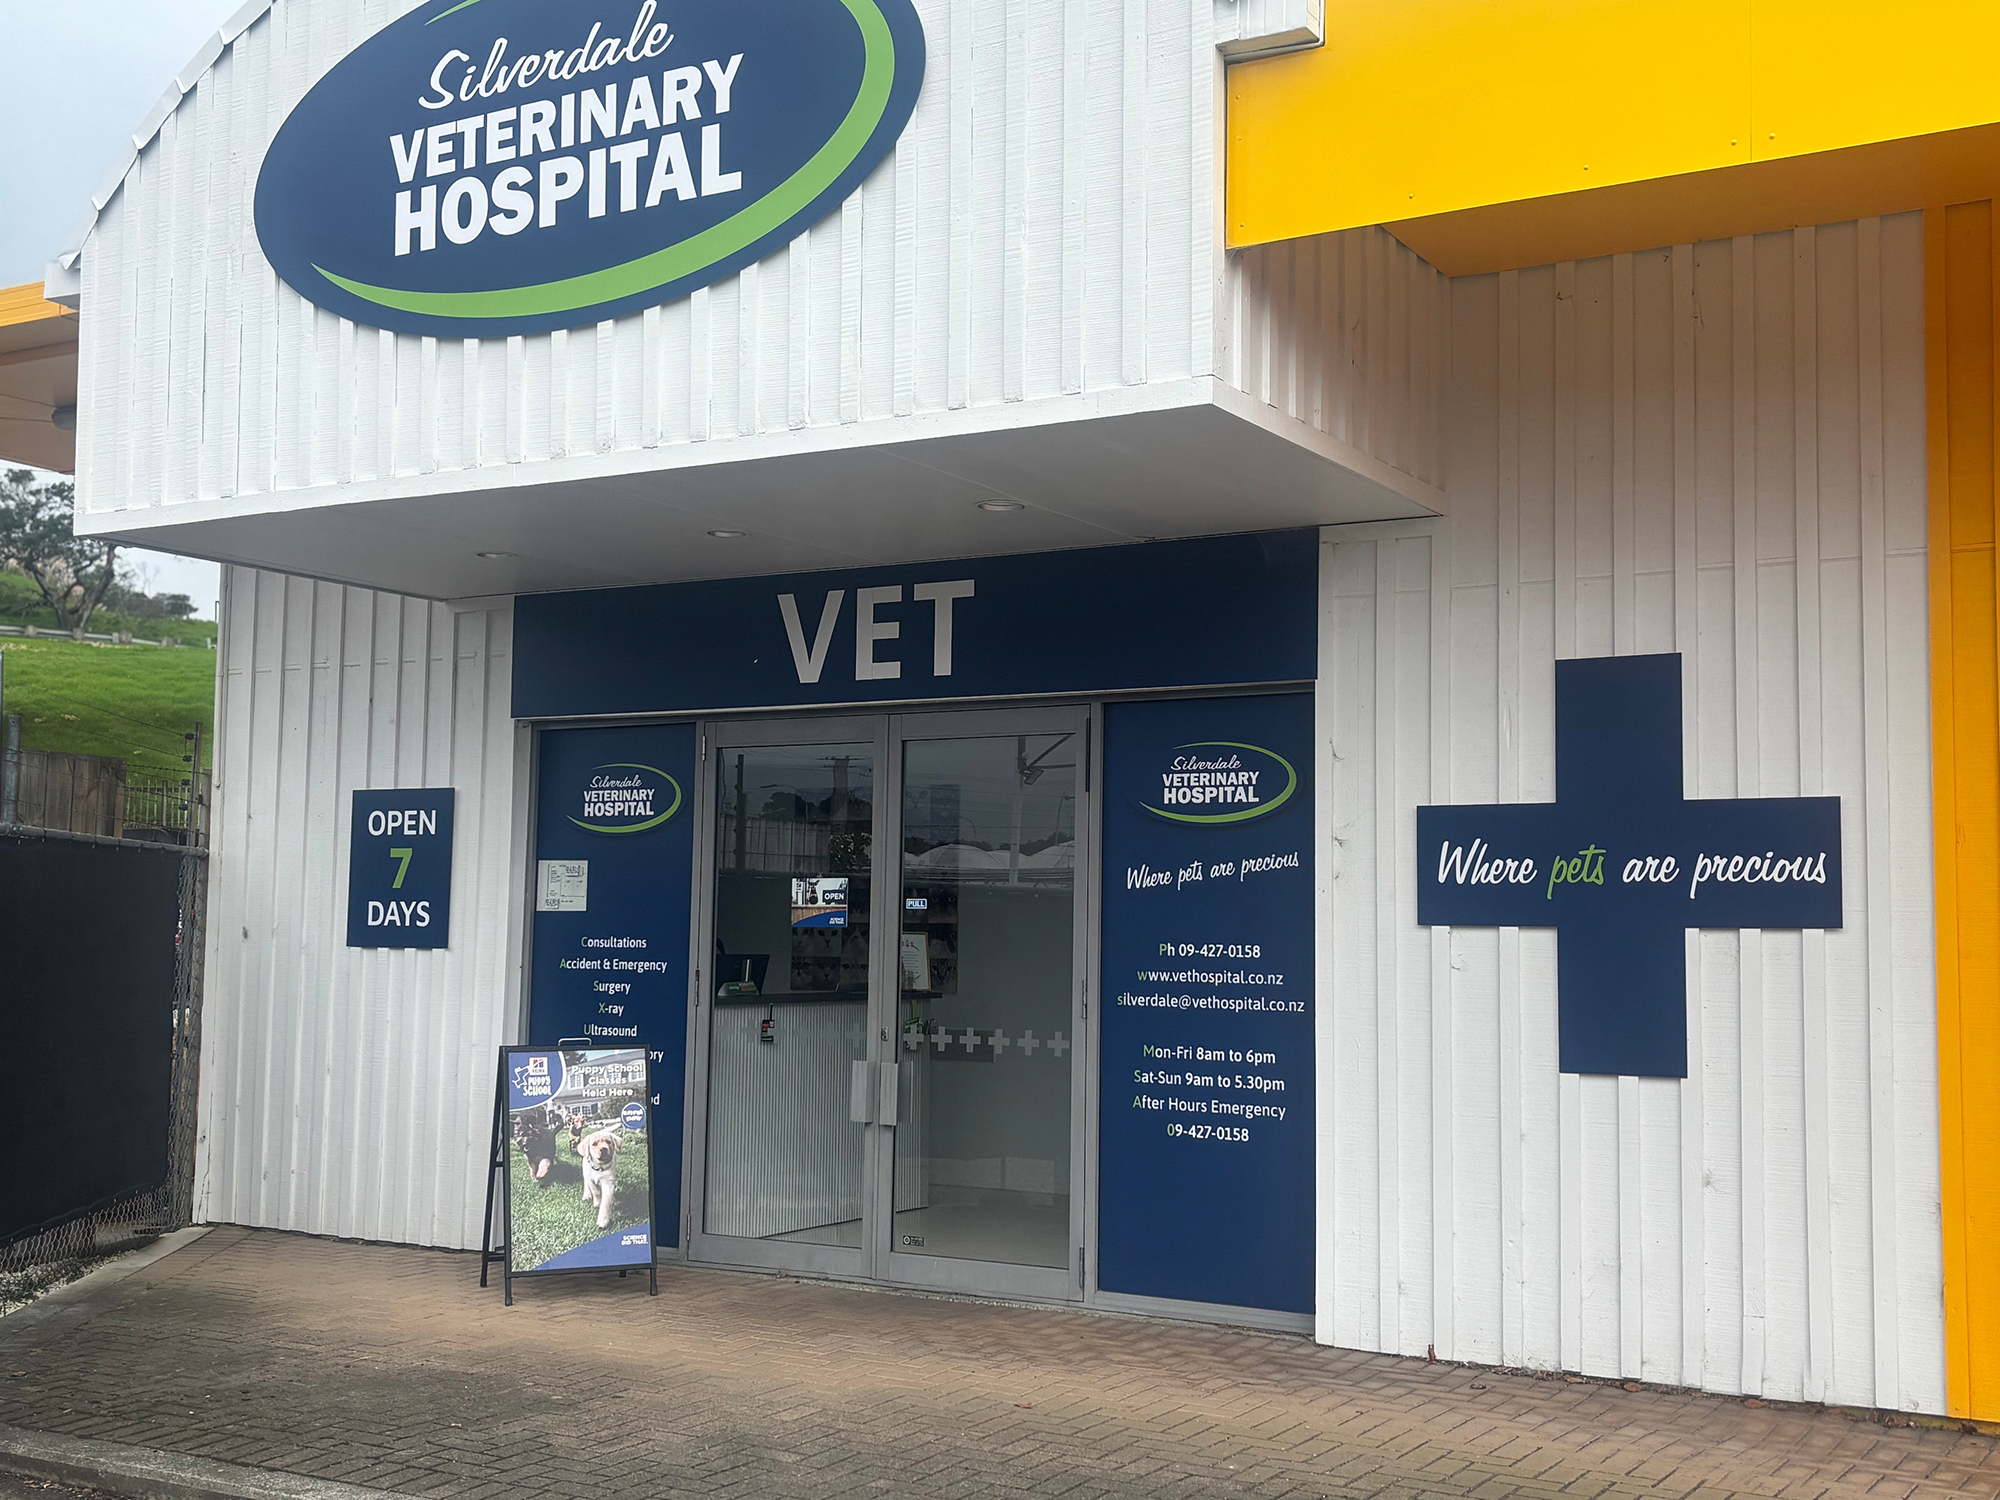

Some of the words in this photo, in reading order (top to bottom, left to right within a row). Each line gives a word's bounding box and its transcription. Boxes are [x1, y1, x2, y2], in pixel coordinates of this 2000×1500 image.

[418, 0, 675, 110] Silverdale
[389, 53, 745, 184] VETERINARY
[394, 123, 742, 257] HOSPITAL
[776, 578, 976, 684] VET
[1170, 755, 1242, 770] Silverdale
[590, 774, 642, 788] Silverdale
[1163, 771, 1259, 786] VETERINARY
[583, 789, 655, 802] VETERINARY
[1164, 785, 1259, 804] HOSPITAL
[584, 801, 654, 817] HOSPITAL
[367, 809, 437, 837] OPEN
[389, 847, 413, 889] 7
[1126, 863, 1173, 891] Where
[1177, 860, 1203, 891] pets
[1210, 862, 1236, 879] are
[1240, 851, 1299, 883] precious
[1437, 838, 1538, 886] Where
[1546, 844, 1607, 900] pets
[1621, 853, 1680, 885] are
[1689, 850, 1827, 900] precious
[367, 900, 430, 928] DAYS
[581, 936, 646, 949] Consultations
[1159, 943, 1175, 958] Ph
[1179, 943, 1261, 958] 09-427-0158
[559, 958, 601, 970] Accident
[603, 958, 611, 970] &
[613, 959, 667, 973] Emergency
[1137, 969, 1284, 986] www.vethospital.co.nz
[593, 980, 631, 994] Surgery
[598, 1003, 624, 1016] X-ray
[1117, 992, 1305, 1012] silverdale@vethospital.co.nz
[584, 1024, 637, 1036] Ultrasound
[1143, 1044, 1193, 1060] Mon-Fri
[1196, 1047, 1226, 1063] 8am
[1228, 1049, 1243, 1063] to
[1245, 1051, 1277, 1066] 6pm
[571, 1065, 605, 1074] Puppy
[528, 1076, 550, 1086] PUPPY
[588, 1077, 627, 1085] Classes
[1134, 1069, 1182, 1085] Sat-Sun
[1184, 1072, 1215, 1087] 9am
[1217, 1073, 1231, 1088] to
[1234, 1075, 1285, 1093] 5.30pm
[523, 1085, 552, 1096] SCHOOL
[582, 1088, 606, 1098] Held
[609, 1088, 633, 1096] Here
[1132, 1095, 1166, 1112] After
[1168, 1097, 1208, 1114] Hours
[1211, 1100, 1286, 1120] Emergency
[1167, 1124, 1249, 1141] 09-427-0158
